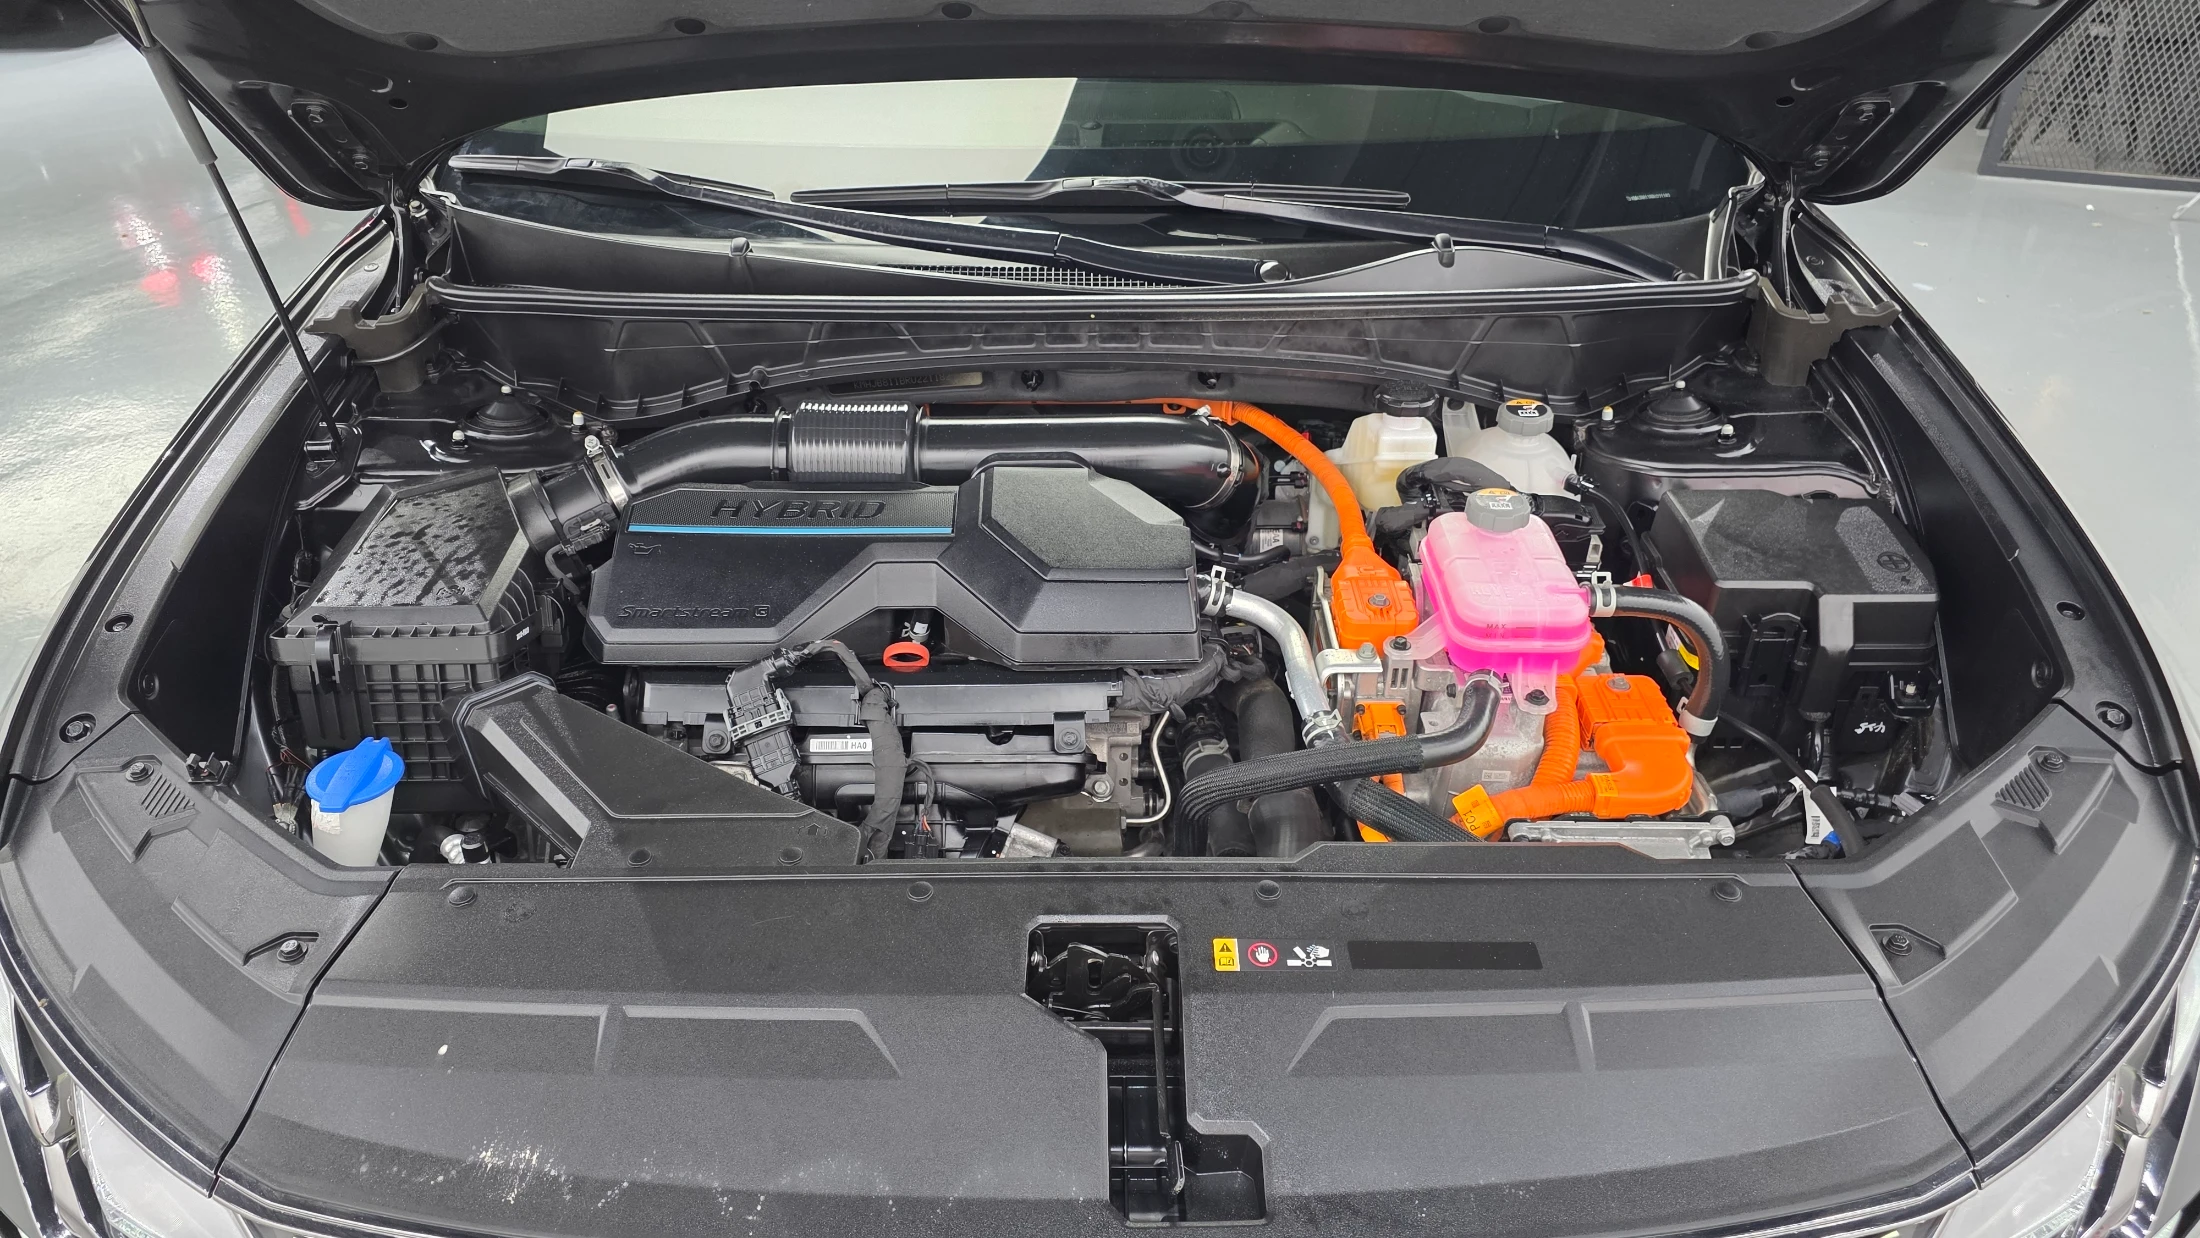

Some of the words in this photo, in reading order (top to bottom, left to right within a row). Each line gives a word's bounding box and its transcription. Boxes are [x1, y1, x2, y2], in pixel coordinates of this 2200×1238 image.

[710, 500, 886, 519] HYBRID
[618, 605, 749, 618] Smartstream
[1463, 810, 1480, 831] PC1
